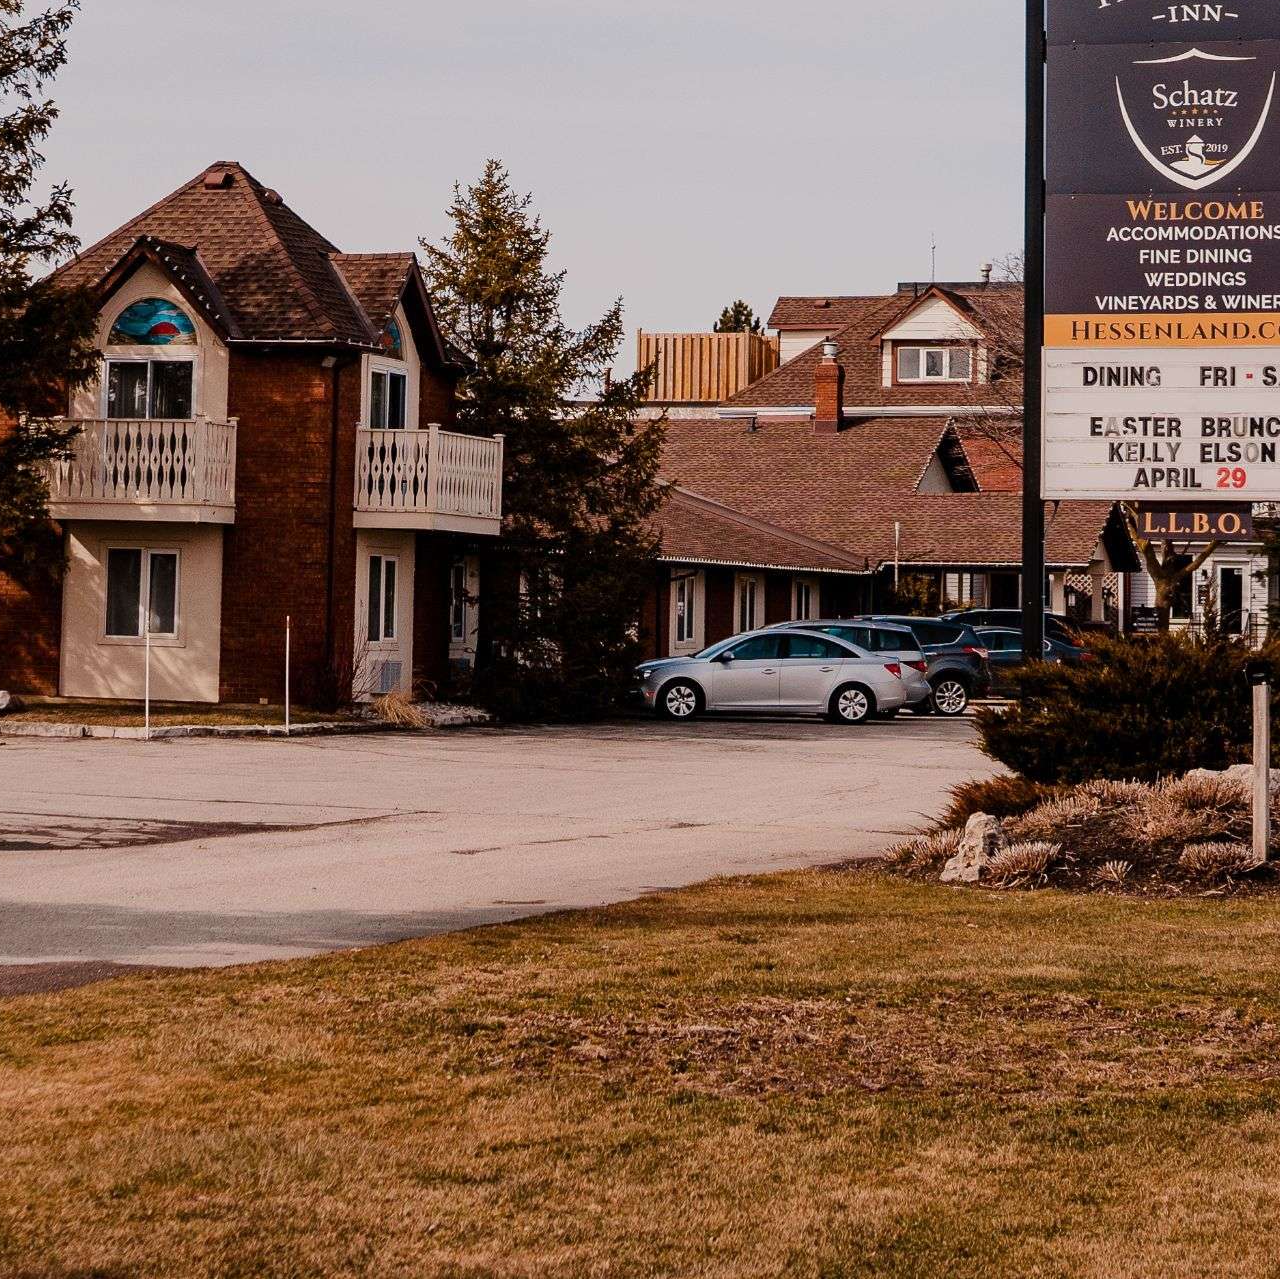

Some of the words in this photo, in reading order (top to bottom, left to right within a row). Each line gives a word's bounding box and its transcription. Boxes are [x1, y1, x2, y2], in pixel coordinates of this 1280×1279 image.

[1152, 80, 1238, 109] Schatz
[1167, 117, 1224, 128] WINERY
[1160, 144, 1183, 156] EST.
[1206, 143, 1229, 153] 2019
[1126, 200, 1265, 221] WELCOME
[1139, 249, 1180, 264] FINE
[1186, 248, 1252, 264] DINING
[1144, 271, 1247, 287] WEDDINGS
[1095, 295, 1199, 311] VINEYARDS
[1204, 295, 1218, 310] &
[1082, 366, 1161, 387] DINING
[1199, 366, 1236, 387] FRI
[1089, 416, 1182, 438] EASTER
[1108, 442, 1181, 463] KELLY
[1200, 442, 1276, 463] ELSON
[1133, 467, 1202, 488] APRIL
[1216, 467, 1247, 488] 29
[1143, 512, 1247, 534] L.L.B.O.
